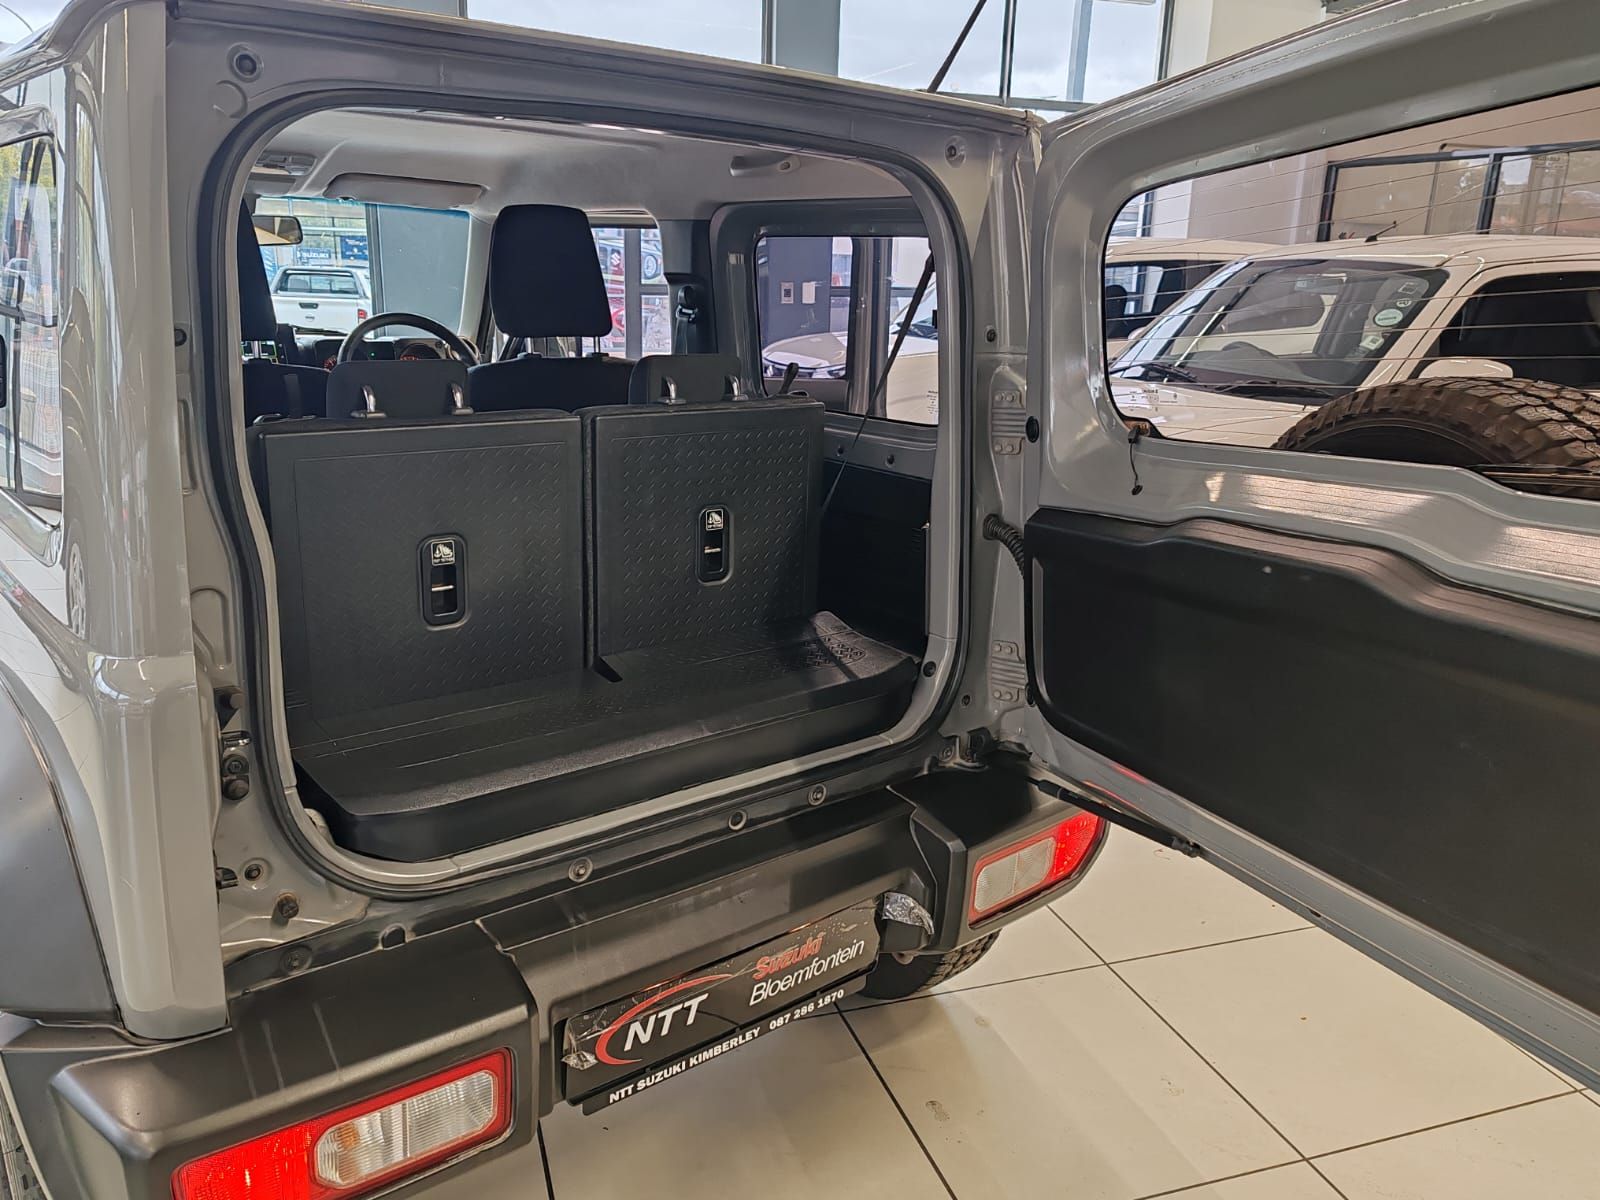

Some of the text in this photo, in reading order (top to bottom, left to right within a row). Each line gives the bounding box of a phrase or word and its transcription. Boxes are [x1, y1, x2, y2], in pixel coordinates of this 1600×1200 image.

[749, 939, 865, 1006] Bloemfontein
[752, 932, 826, 980] Suzuki
[609, 1084, 634, 1104] NTT
[636, 1060, 686, 1091] SUZUKI
[689, 1026, 761, 1067] KIMBERLEY
[769, 1013, 791, 1030] 087
[817, 989, 844, 1009] 1870
[623, 993, 709, 1052] NTT
